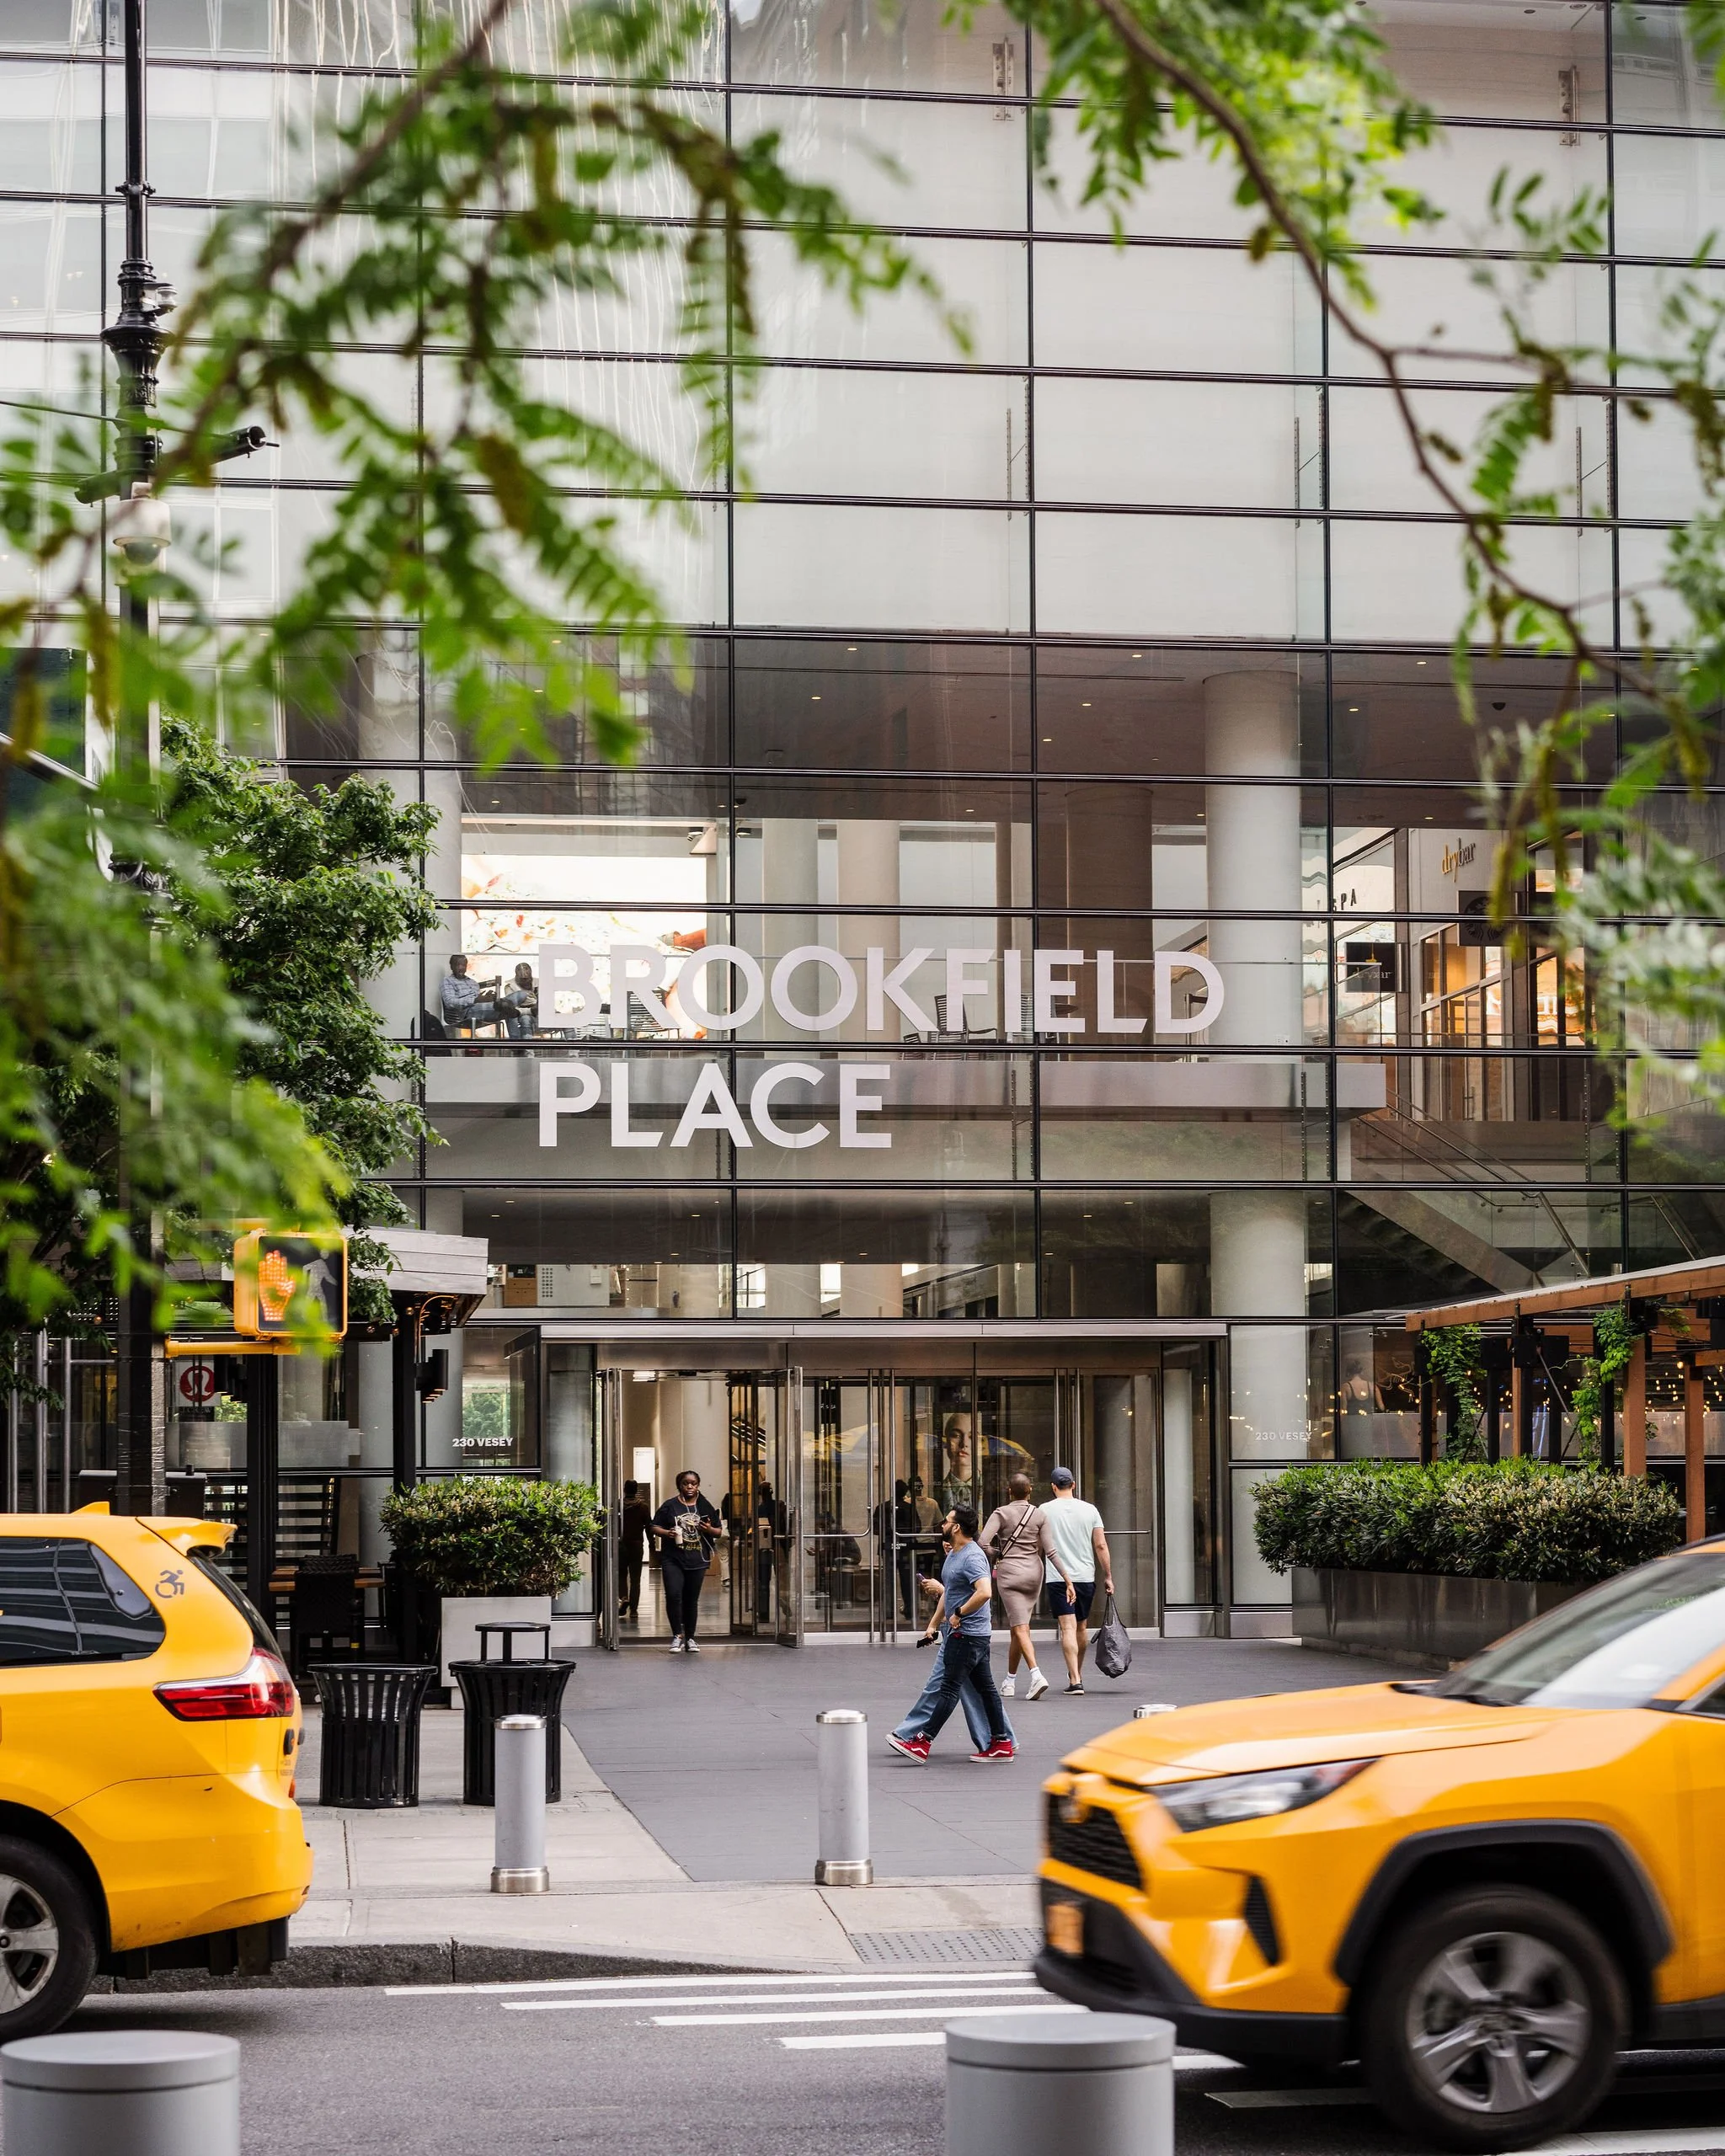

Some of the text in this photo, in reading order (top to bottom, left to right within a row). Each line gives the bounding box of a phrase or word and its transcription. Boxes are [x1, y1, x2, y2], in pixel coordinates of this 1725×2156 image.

[1442, 837, 1477, 883] drybar
[538, 943, 1226, 1034] BROOKFIELD
[539, 1061, 892, 1149] PLACE
[452, 1437, 513, 1447] 230 VESEY
[1255, 1431, 1312, 1441] 230 VESEY
